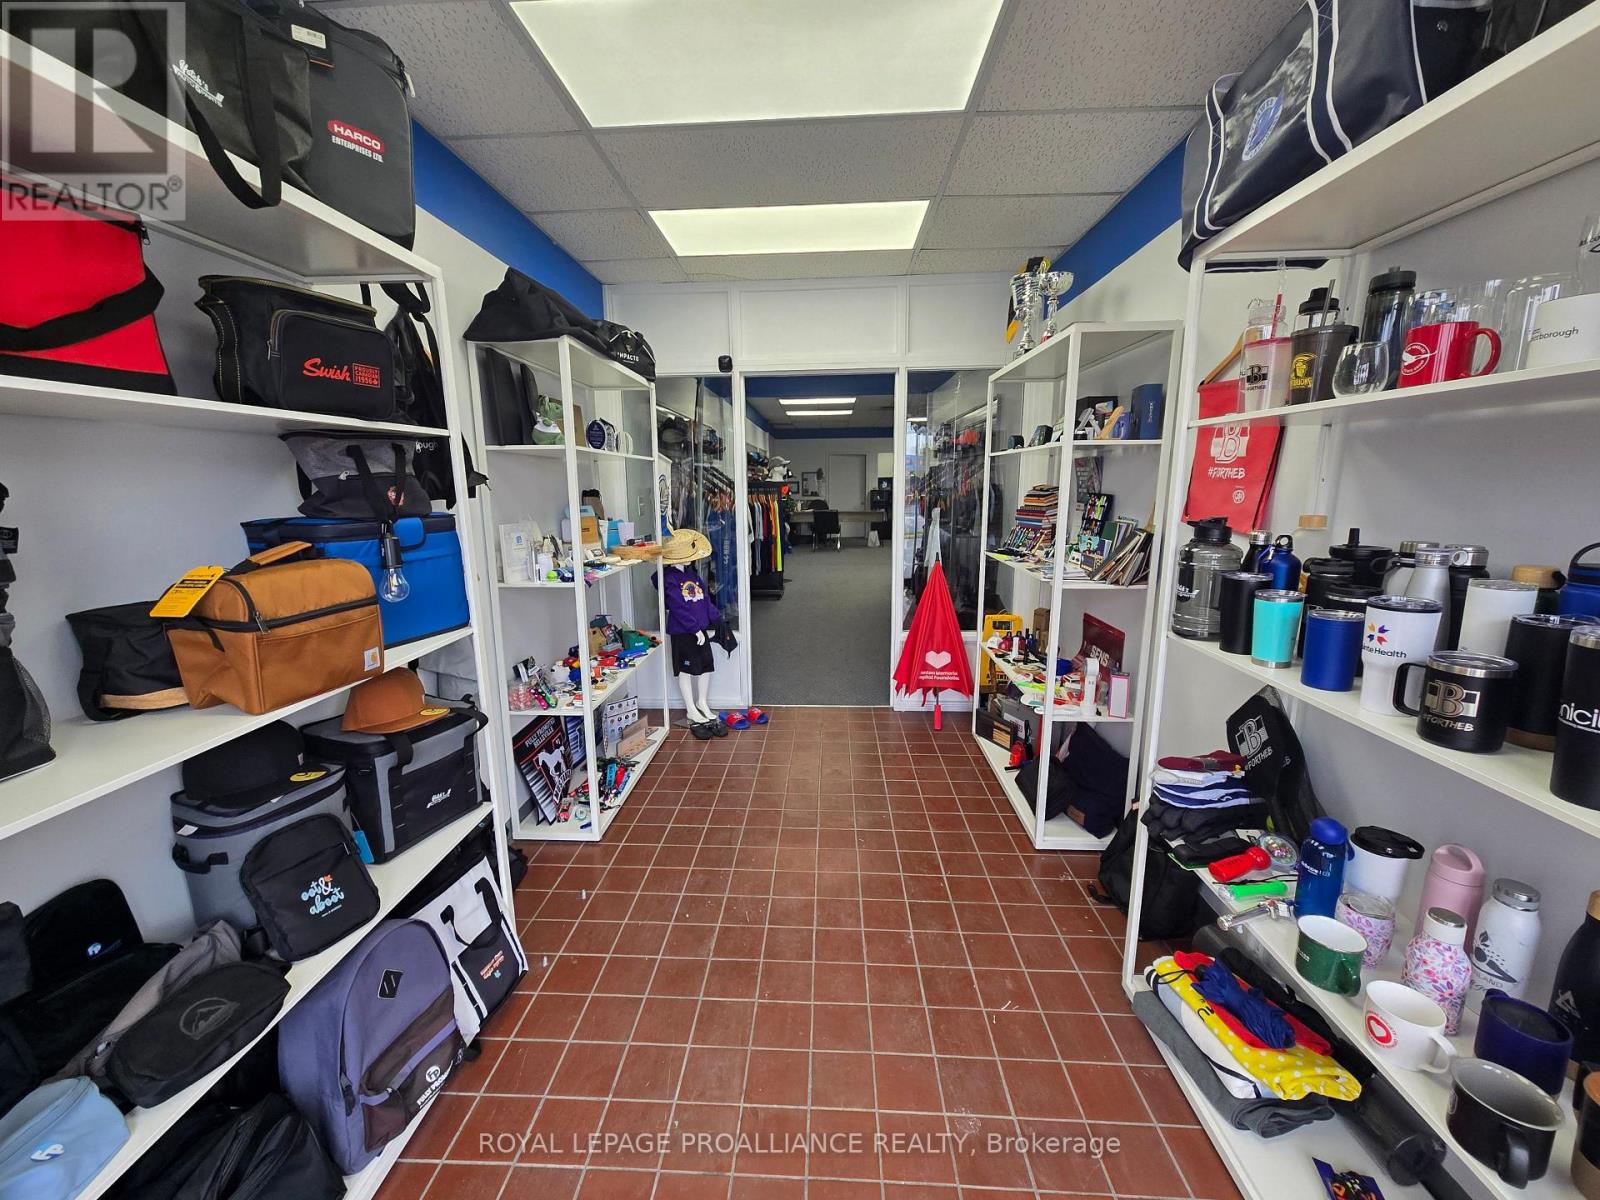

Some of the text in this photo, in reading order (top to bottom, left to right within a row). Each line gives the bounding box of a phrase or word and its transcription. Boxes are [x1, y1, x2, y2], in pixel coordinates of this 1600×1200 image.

[331, 135, 372, 158] ENTERPRISES
[333, 123, 381, 150] HARCO
[303, 357, 352, 382] Swish
[1374, 647, 1407, 658] Health
